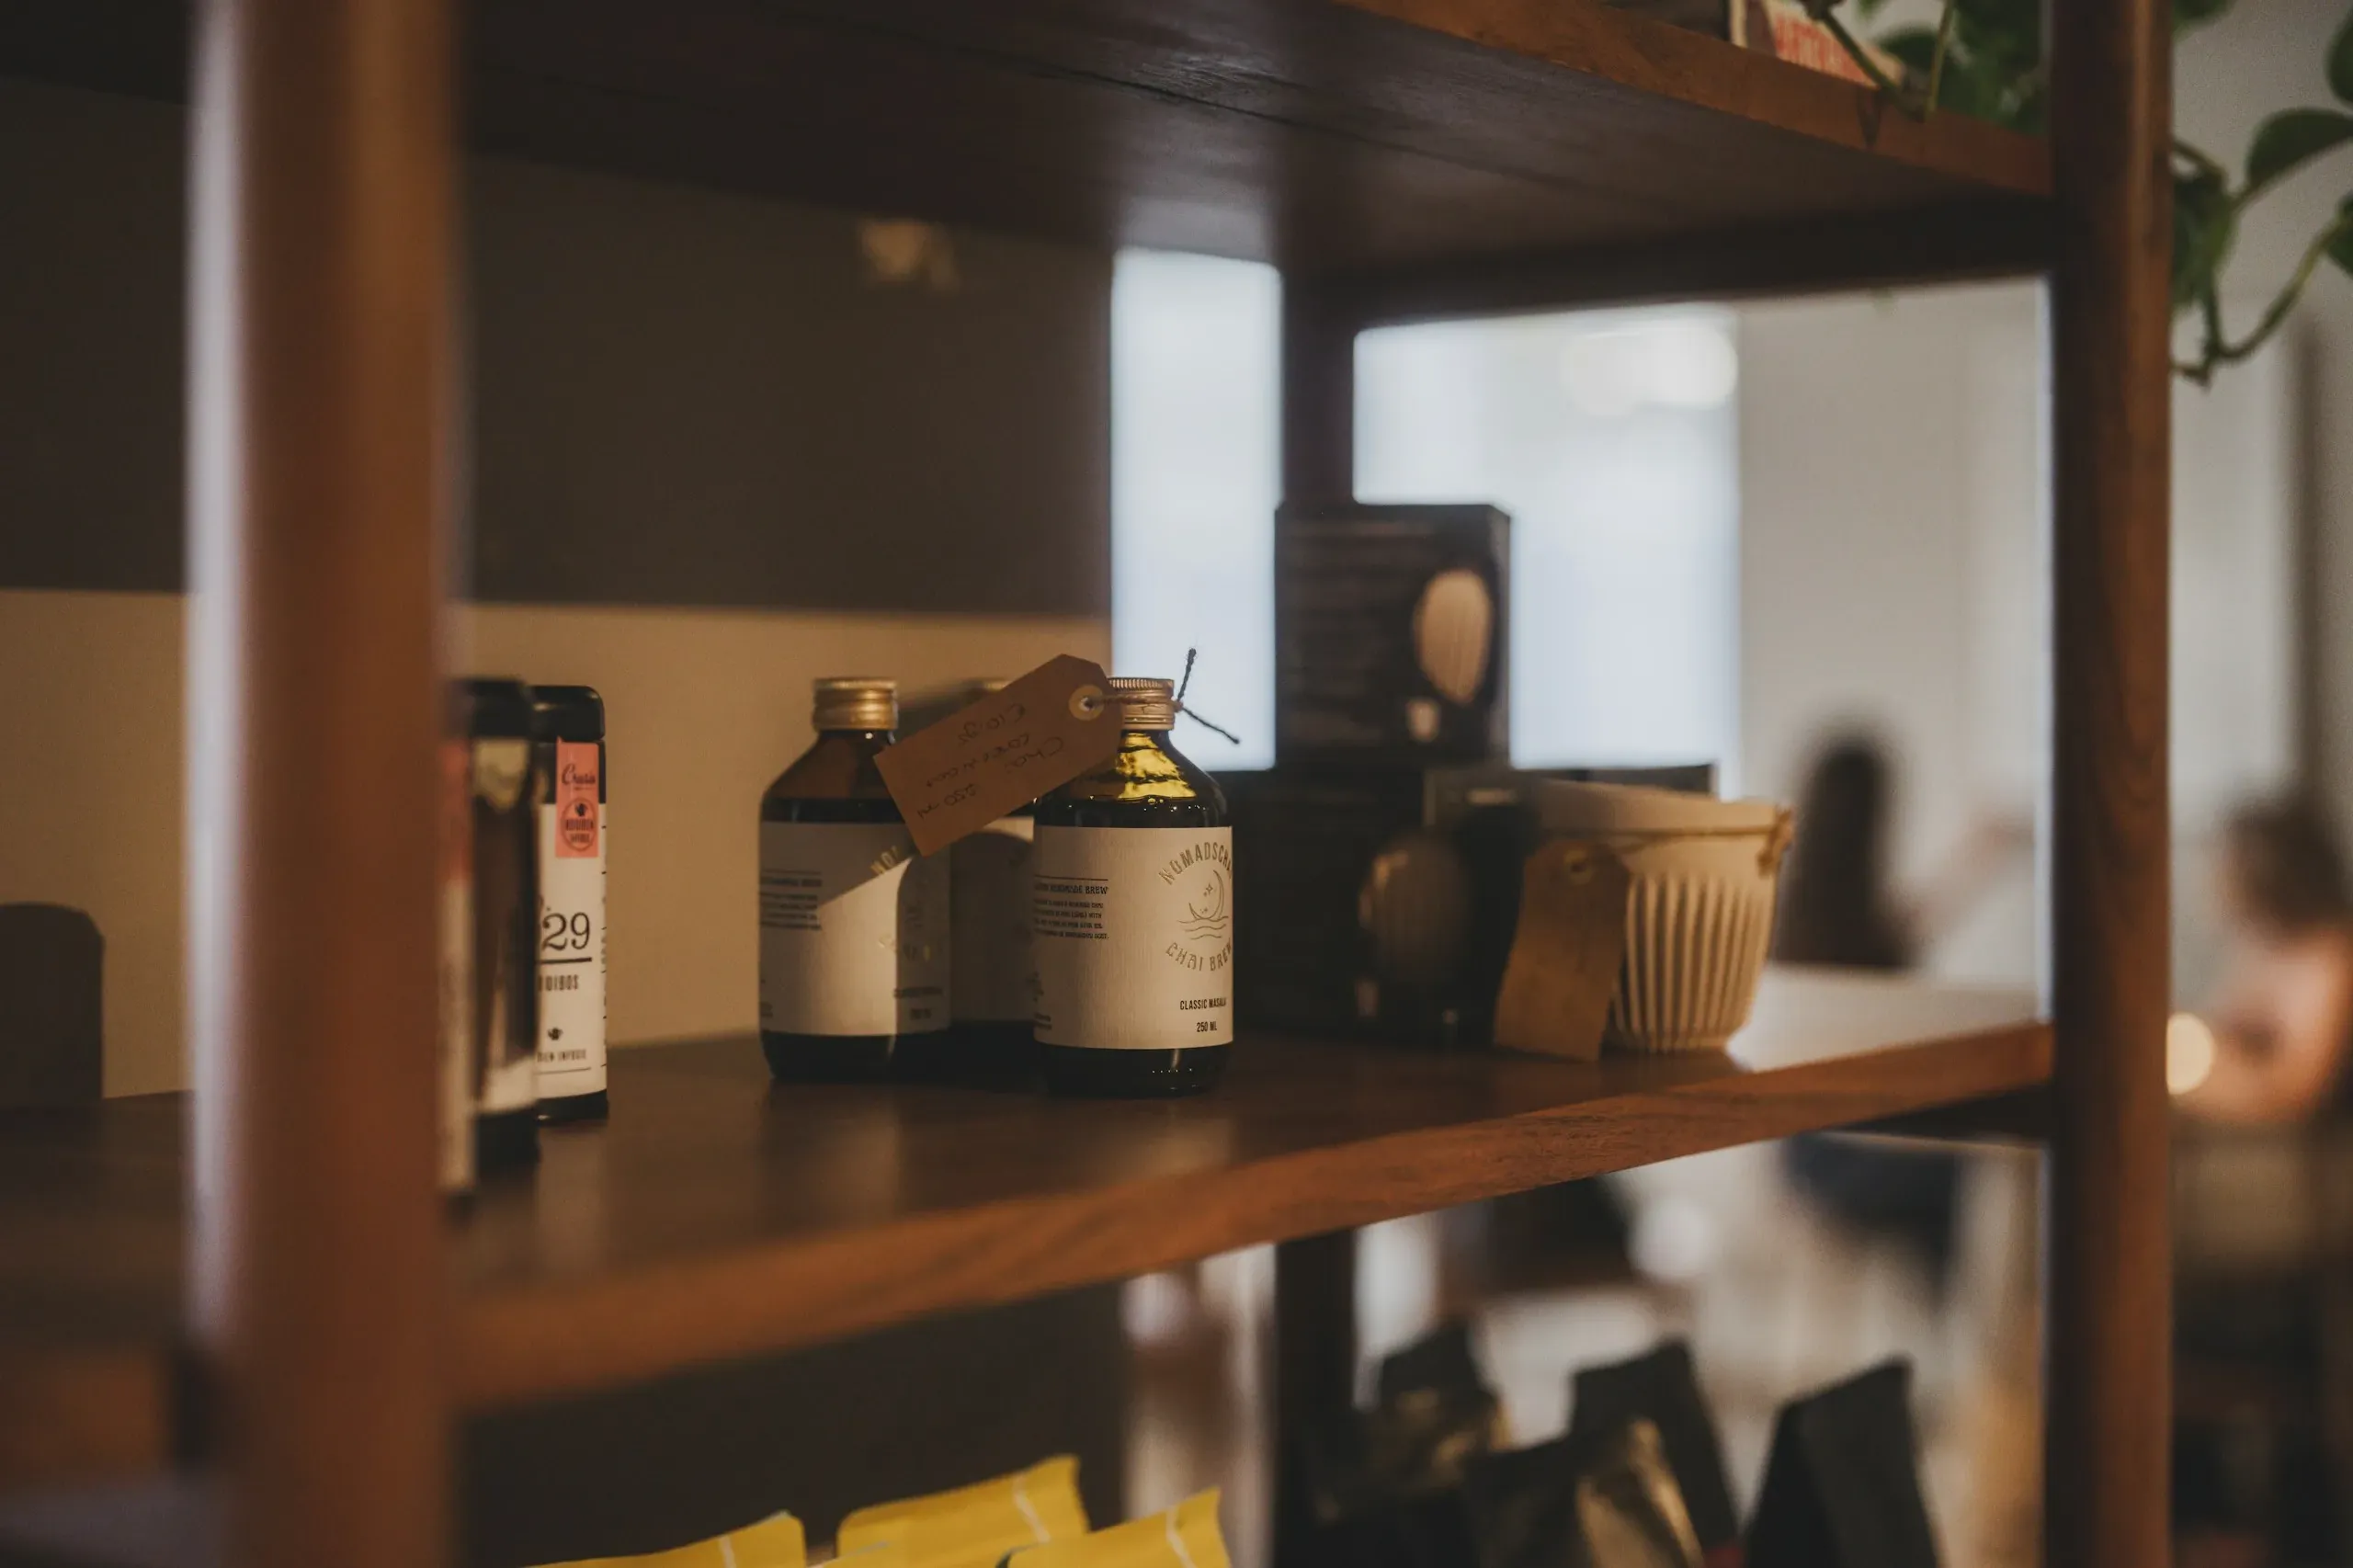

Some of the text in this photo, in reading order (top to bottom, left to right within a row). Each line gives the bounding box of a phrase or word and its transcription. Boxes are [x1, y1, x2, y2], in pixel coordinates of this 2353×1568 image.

[1086, 885, 1108, 895] BREW
[540, 911, 590, 951] 29
[1165, 941, 1204, 971] CHAI
[1179, 998, 1208, 1010] CLASSIC
[1196, 1020, 1218, 1033] 250 ML
